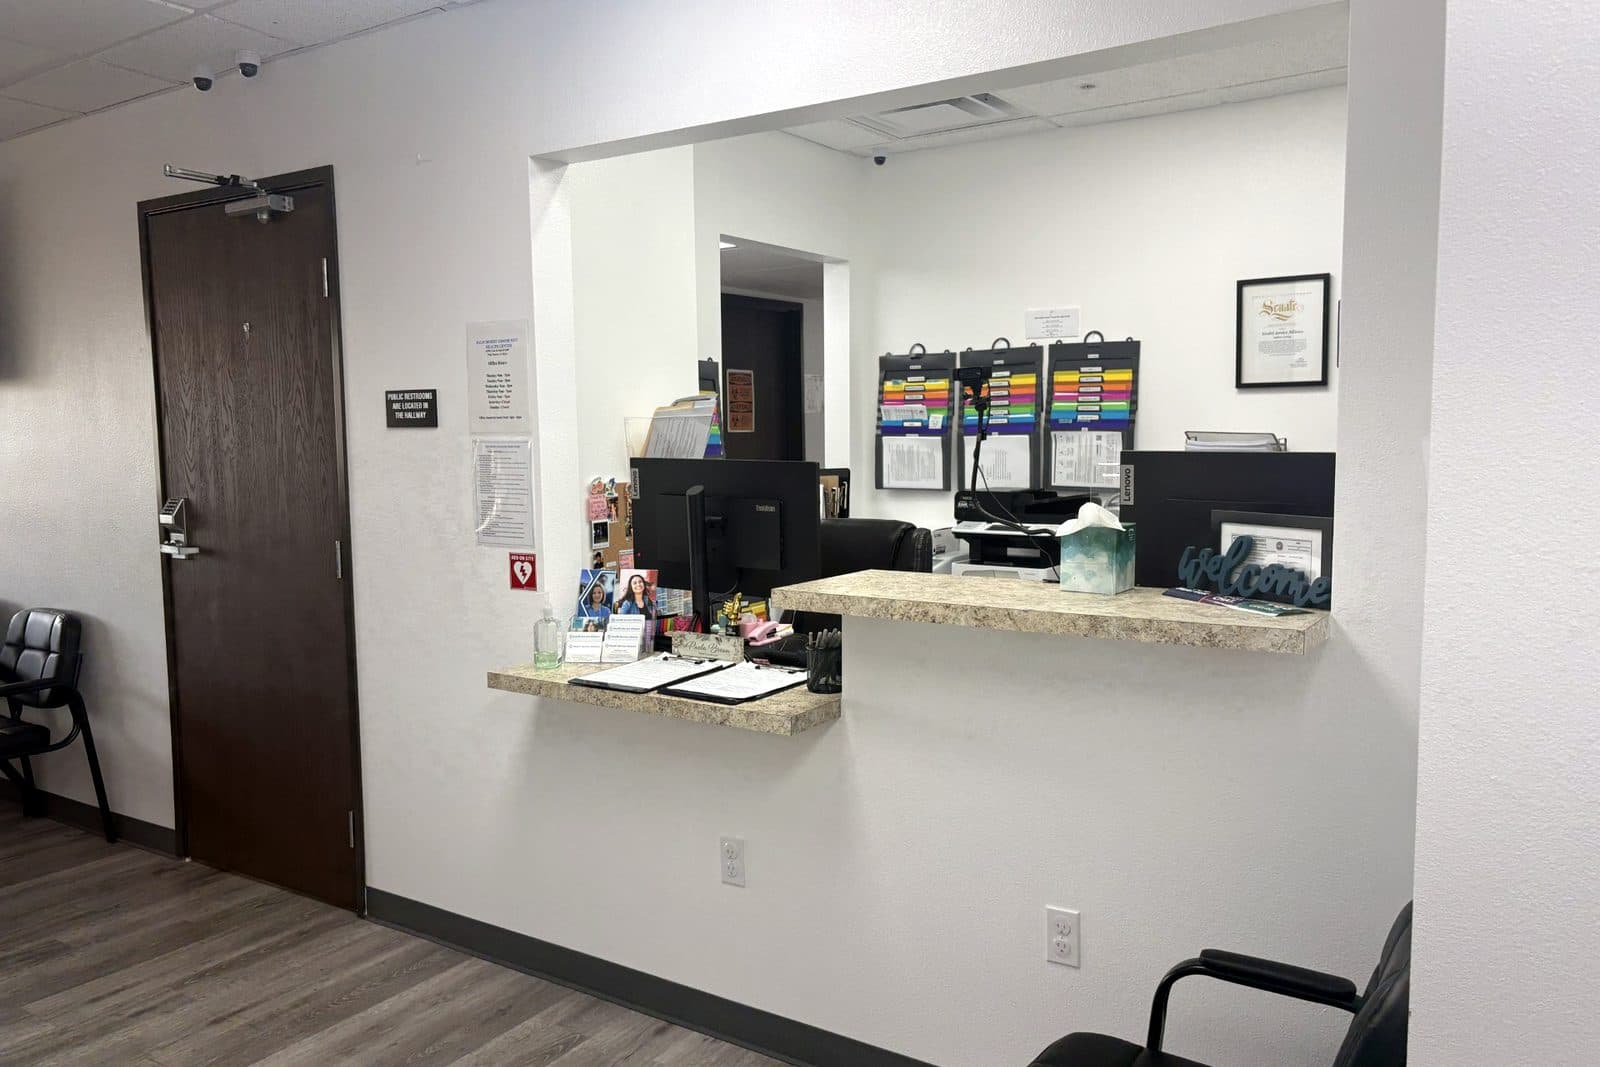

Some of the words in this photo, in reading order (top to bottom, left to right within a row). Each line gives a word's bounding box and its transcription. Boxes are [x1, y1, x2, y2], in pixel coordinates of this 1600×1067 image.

[404, 392, 433, 400] RESTROOMS
[395, 411, 404, 419] THE
[405, 411, 426, 419] HALLWAY
[1122, 468, 1131, 502] Lenovo
[1178, 535, 1331, 606] welcome
